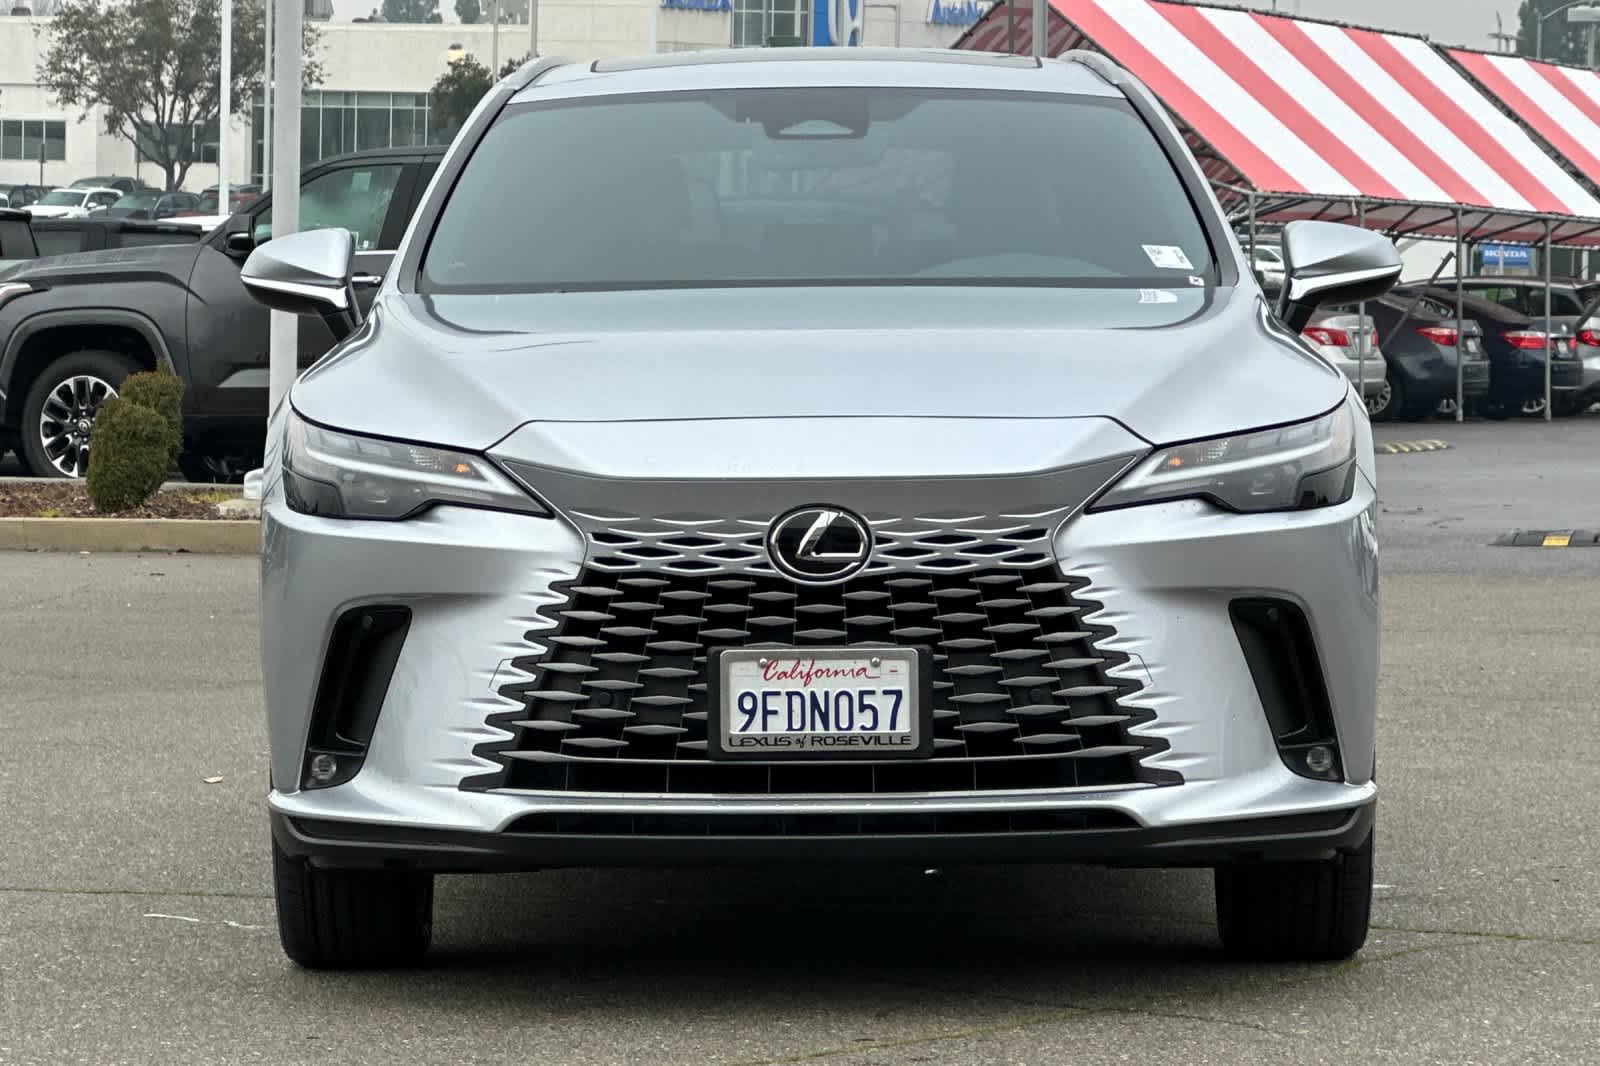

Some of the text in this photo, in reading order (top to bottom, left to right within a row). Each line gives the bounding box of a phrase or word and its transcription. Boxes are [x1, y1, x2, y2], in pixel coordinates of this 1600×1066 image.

[1484, 249, 1528, 258] HONDA
[763, 658, 880, 687] California
[737, 689, 903, 732] 9FDN057
[728, 736, 791, 747] LEXUS
[811, 736, 912, 746] ROSEVILLE
